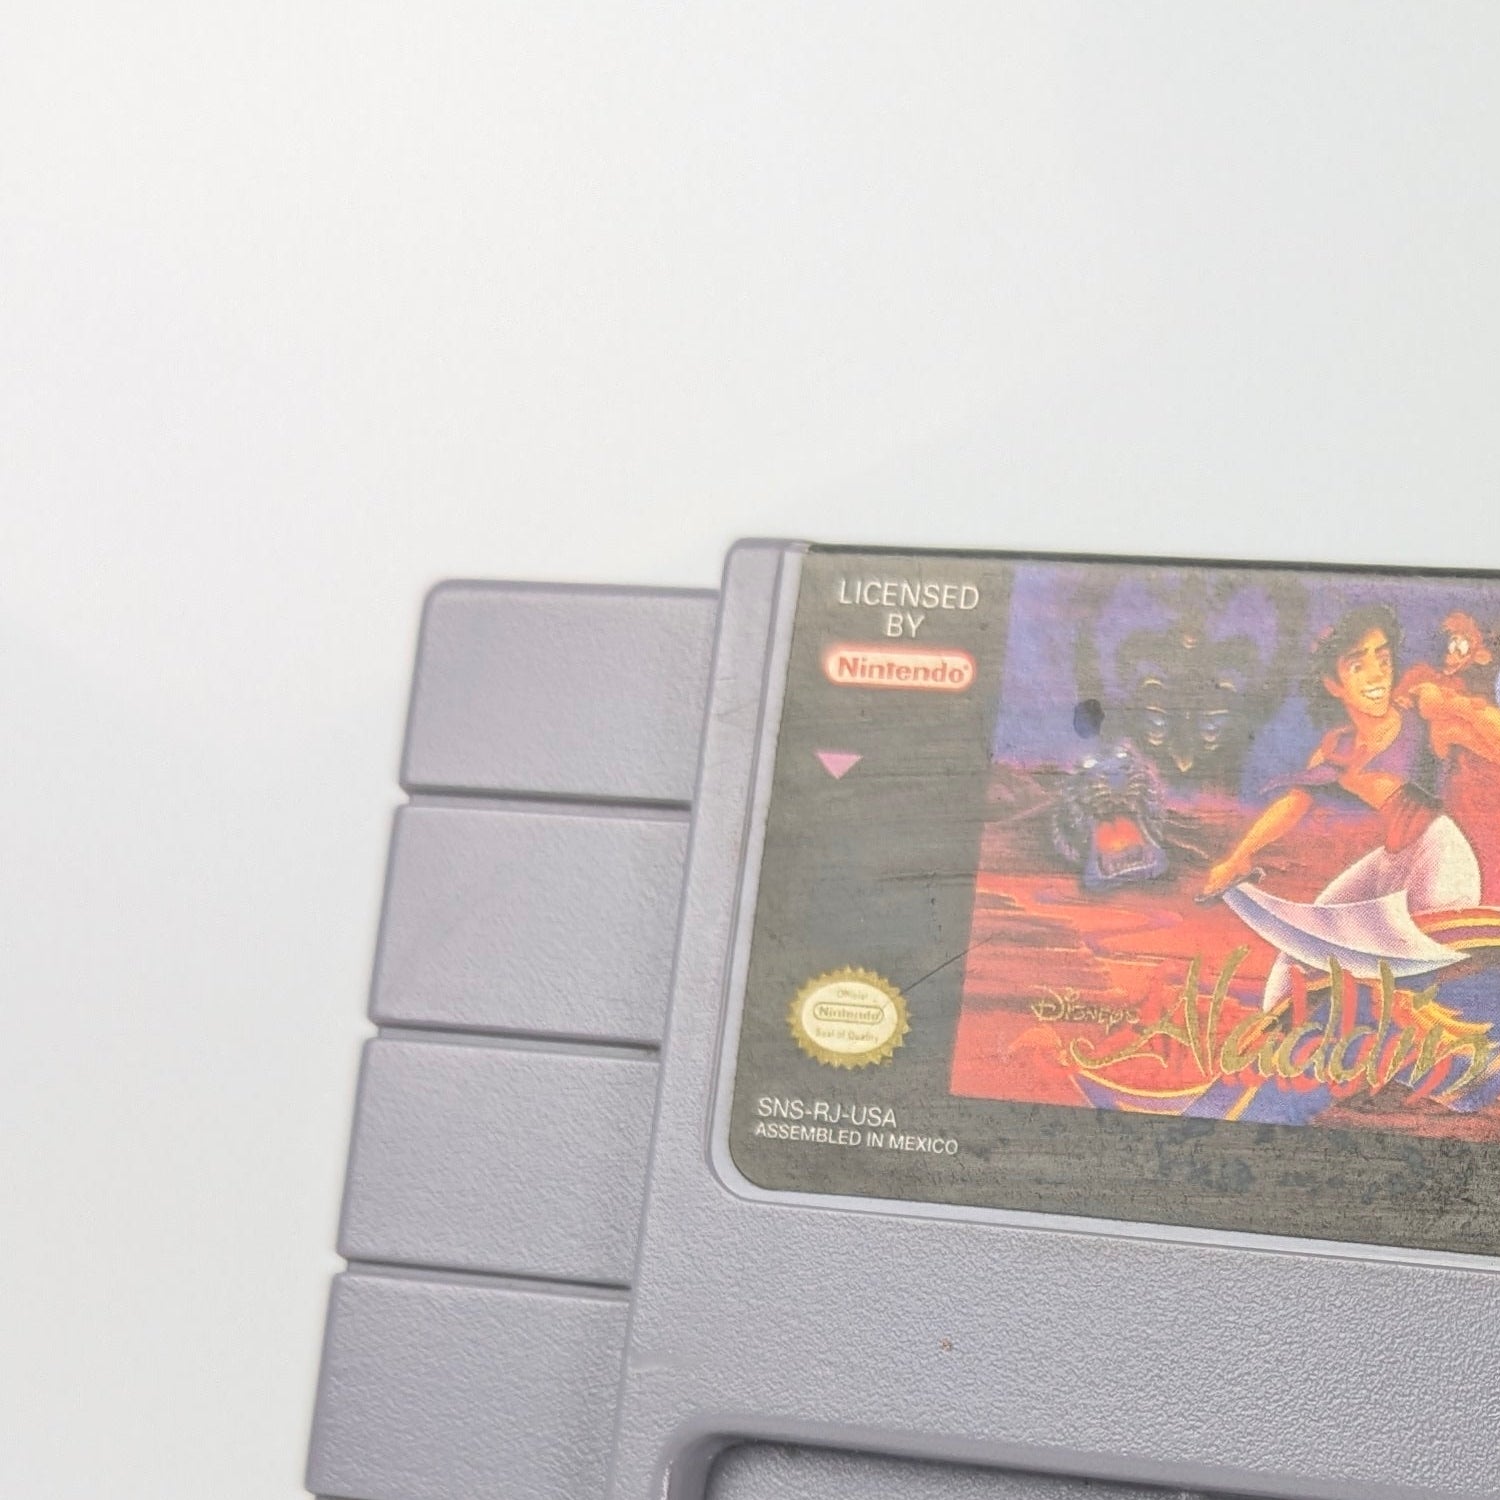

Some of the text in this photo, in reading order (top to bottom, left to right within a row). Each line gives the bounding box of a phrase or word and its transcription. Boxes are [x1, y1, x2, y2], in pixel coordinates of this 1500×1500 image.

[838, 578, 979, 610] LICENSED
[886, 612, 925, 639] BY
[1069, 945, 1494, 1099] Aladdin
[757, 1096, 898, 1128] SNS-RJ-USA
[755, 1121, 959, 1155] ASSEMBLED IN MEXICO
